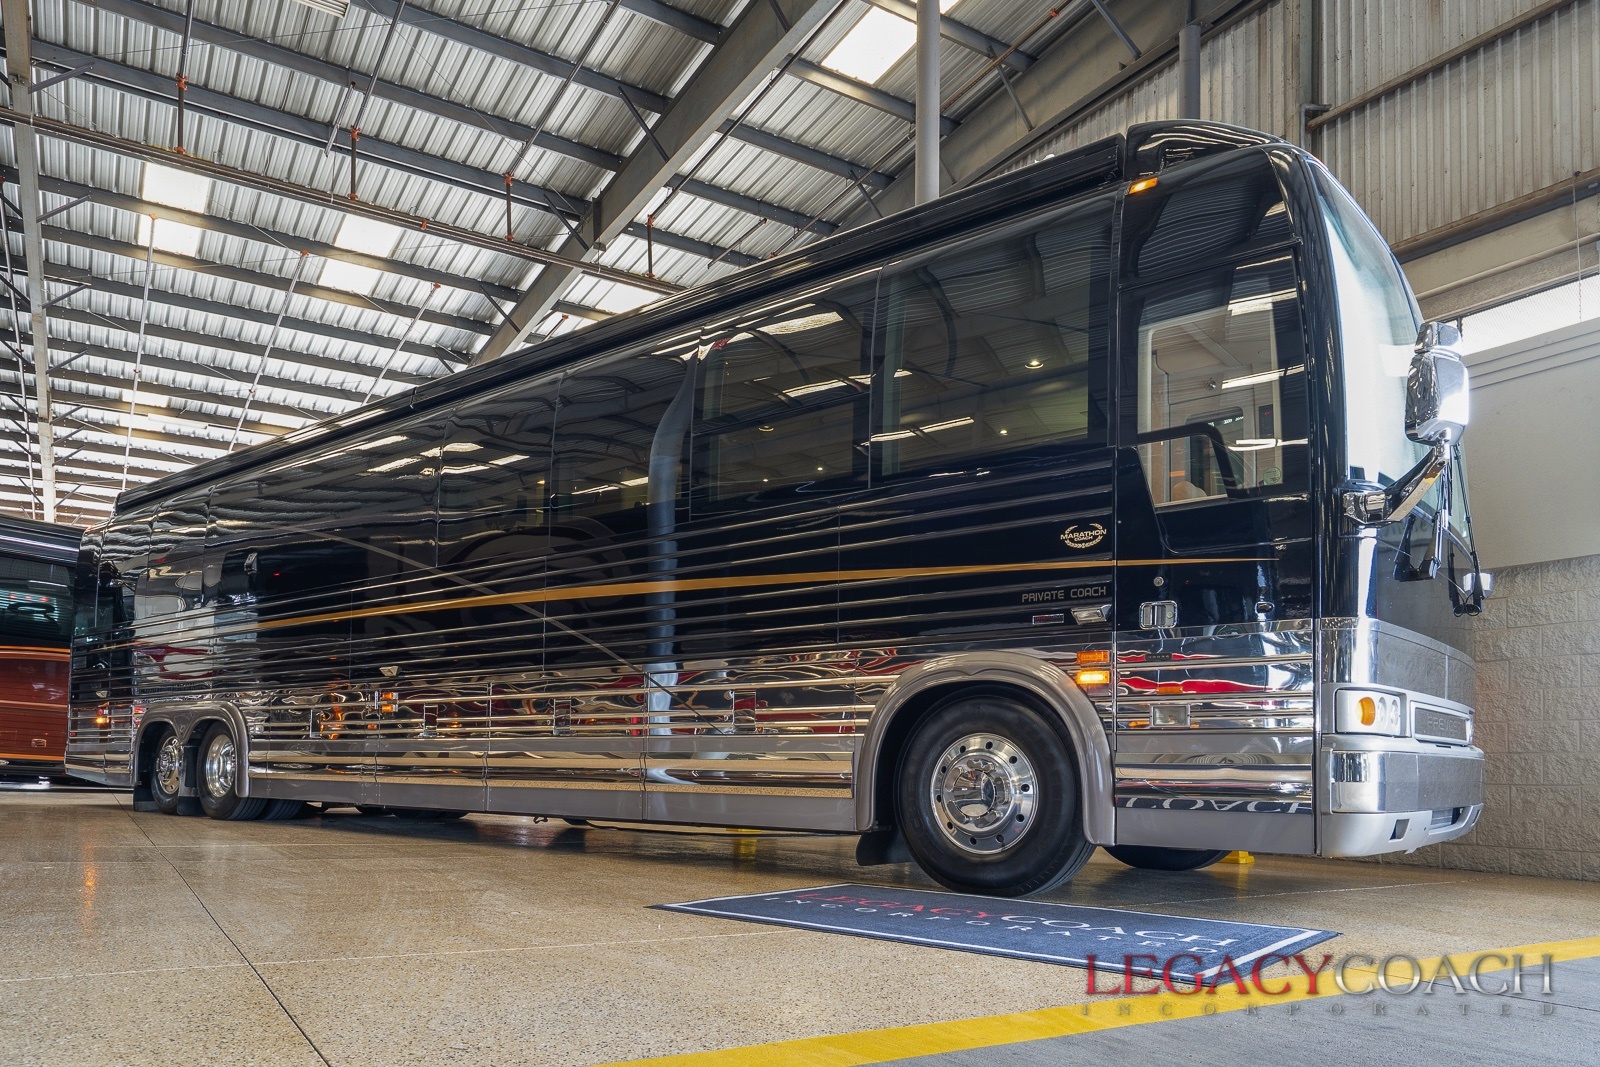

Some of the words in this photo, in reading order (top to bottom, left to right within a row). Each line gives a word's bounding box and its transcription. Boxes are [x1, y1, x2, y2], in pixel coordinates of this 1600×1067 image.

[1060, 529, 1107, 540] MARATHON
[1022, 590, 1065, 603] PRIVATE
[1070, 586, 1107, 598] COACH
